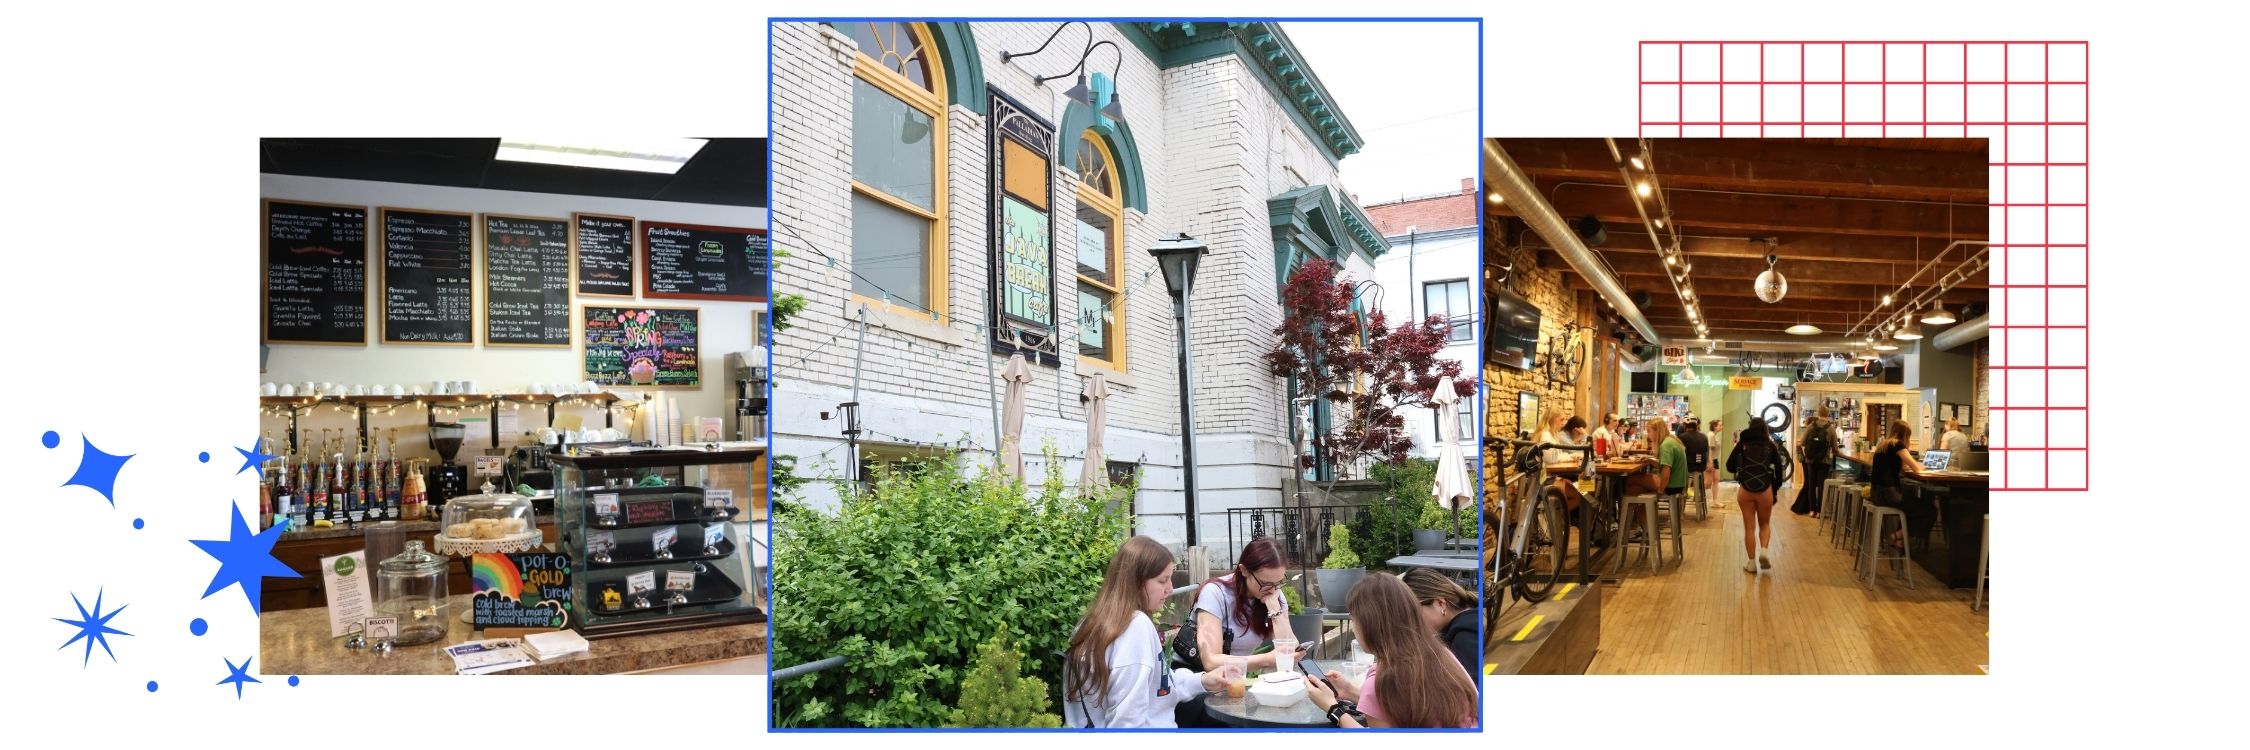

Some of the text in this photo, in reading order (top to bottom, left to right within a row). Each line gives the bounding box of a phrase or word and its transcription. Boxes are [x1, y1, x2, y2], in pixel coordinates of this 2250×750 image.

[388, 216, 415, 226] Espresso
[488, 219, 498, 227] Hot
[498, 220, 509, 228] Tea
[581, 219, 595, 227] Make
[388, 225, 414, 234] Espresso
[416, 227, 448, 236] Macchiato
[647, 227, 663, 236] Fruit
[388, 233, 413, 242] Cortado
[388, 242, 414, 251] Valencia
[1005, 234, 1048, 268] JAVA
[388, 251, 424, 261] Cappuccino
[389, 260, 401, 268] Flat
[402, 261, 422, 269] White
[1006, 262, 1048, 296] BREAK
[489, 301, 502, 309] Cold
[625, 326, 662, 348] SPRING
[622, 345, 661, 366] Specials
[1664, 347, 1685, 357] BIKE
[529, 569, 564, 587] GOLD
[543, 585, 572, 601] brew
[494, 599, 516, 609] brew
[476, 608, 554, 618] with toasted marsh
[475, 616, 492, 625] and
[493, 615, 515, 625] cloud
